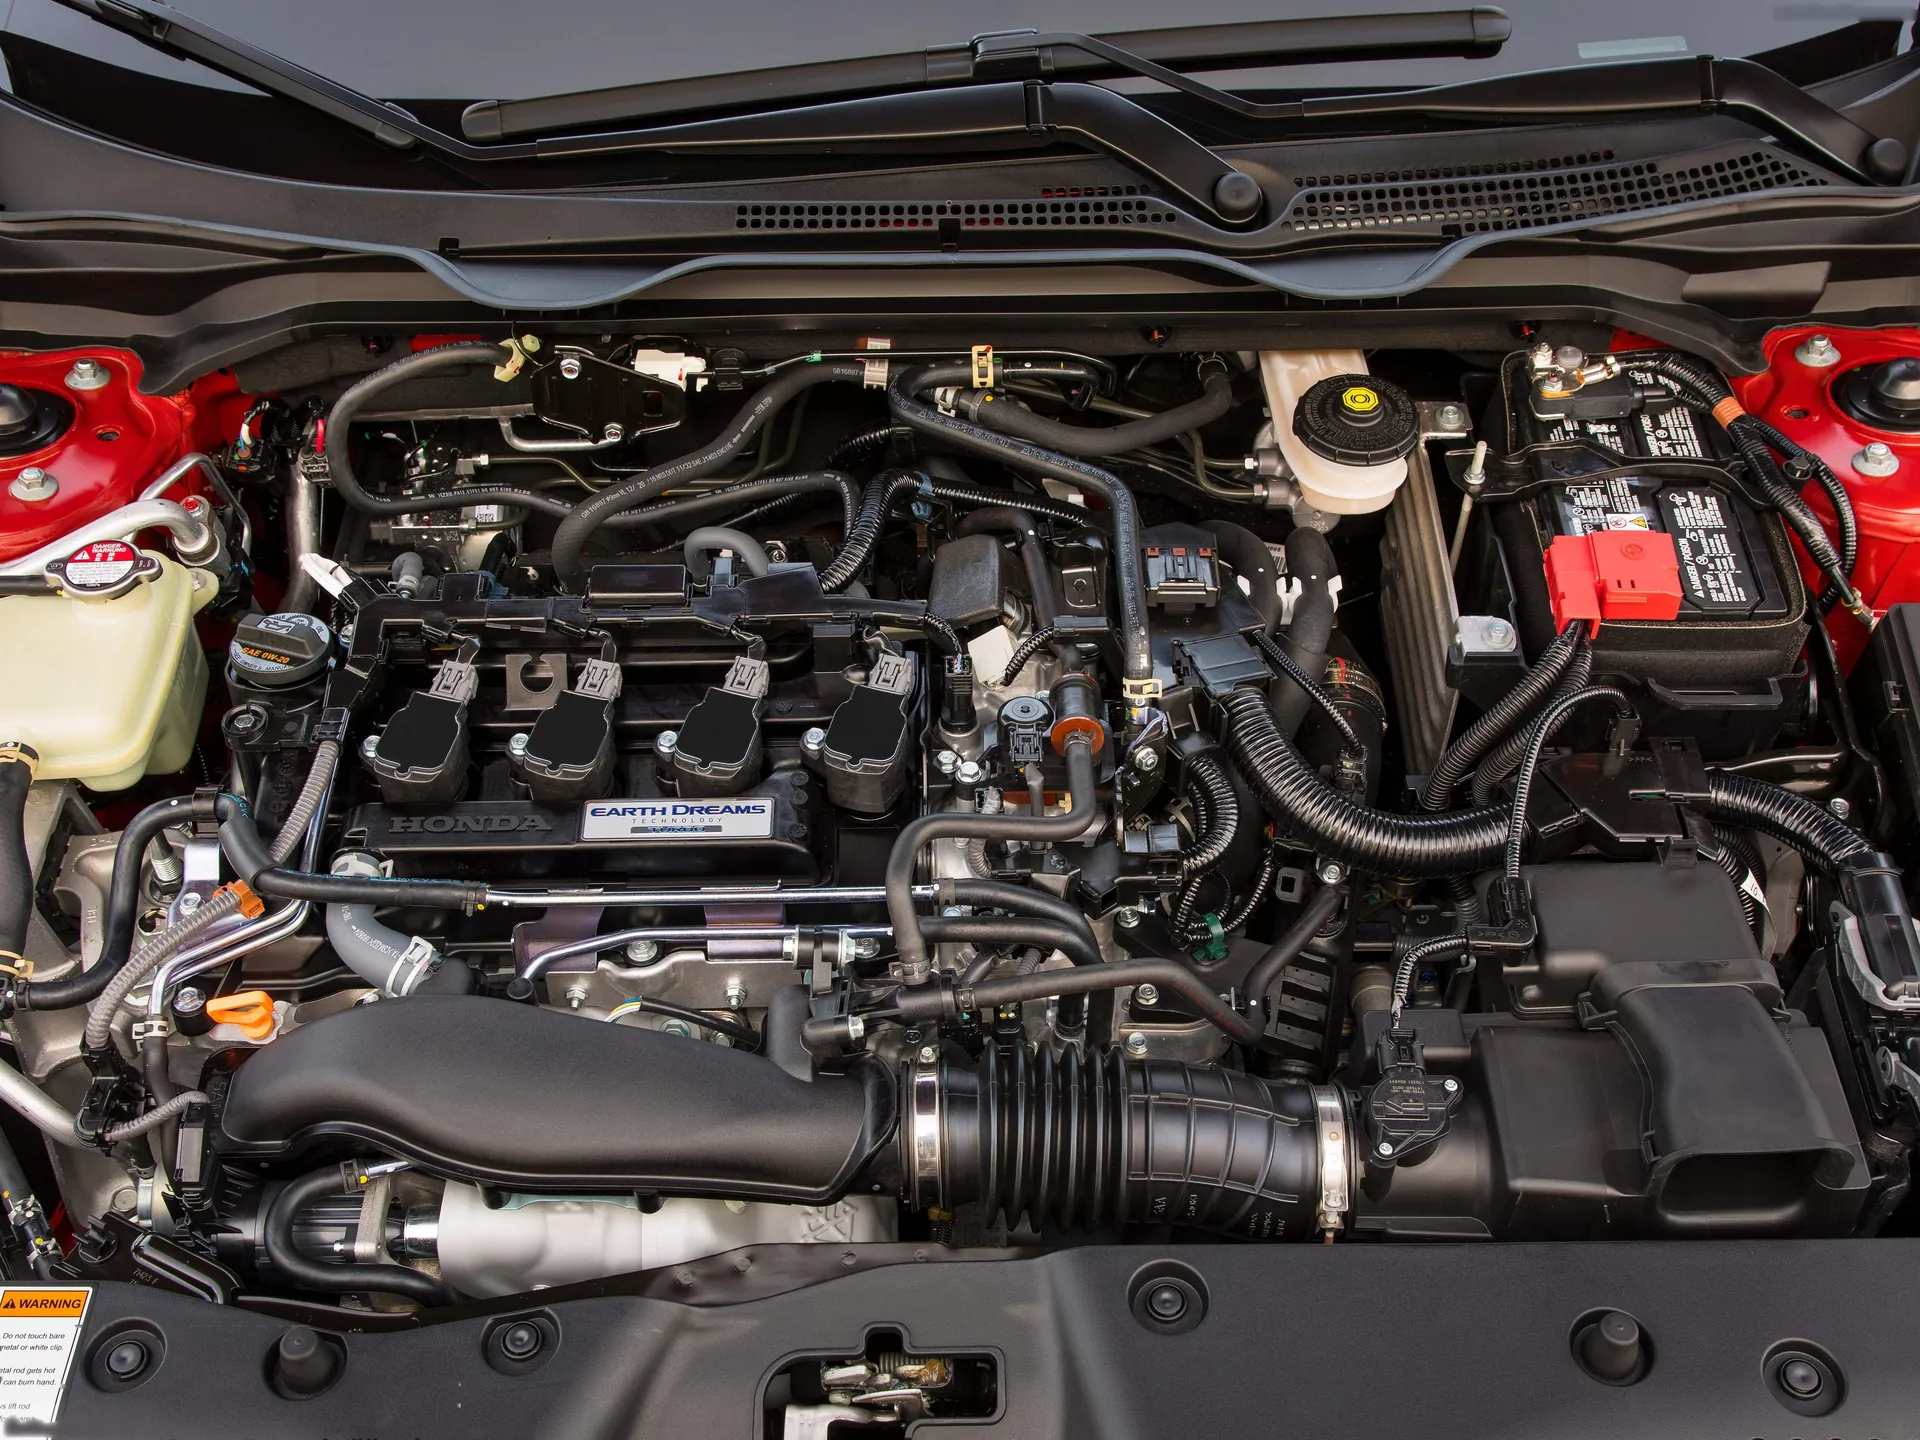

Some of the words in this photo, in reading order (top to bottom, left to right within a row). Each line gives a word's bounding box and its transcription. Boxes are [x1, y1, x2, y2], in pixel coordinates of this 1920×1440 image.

[241, 647, 262, 658] SAE
[261, 652, 290, 664] 0W-20
[590, 805, 667, 817] EARTH
[671, 804, 766, 816] DREAMS
[389, 814, 552, 834] HONDA
[648, 825, 706, 833] TURBO
[19, 1299, 82, 1309] WARNING
[50, 1344, 63, 1352] clip.
[27, 1368, 42, 1376] gets
